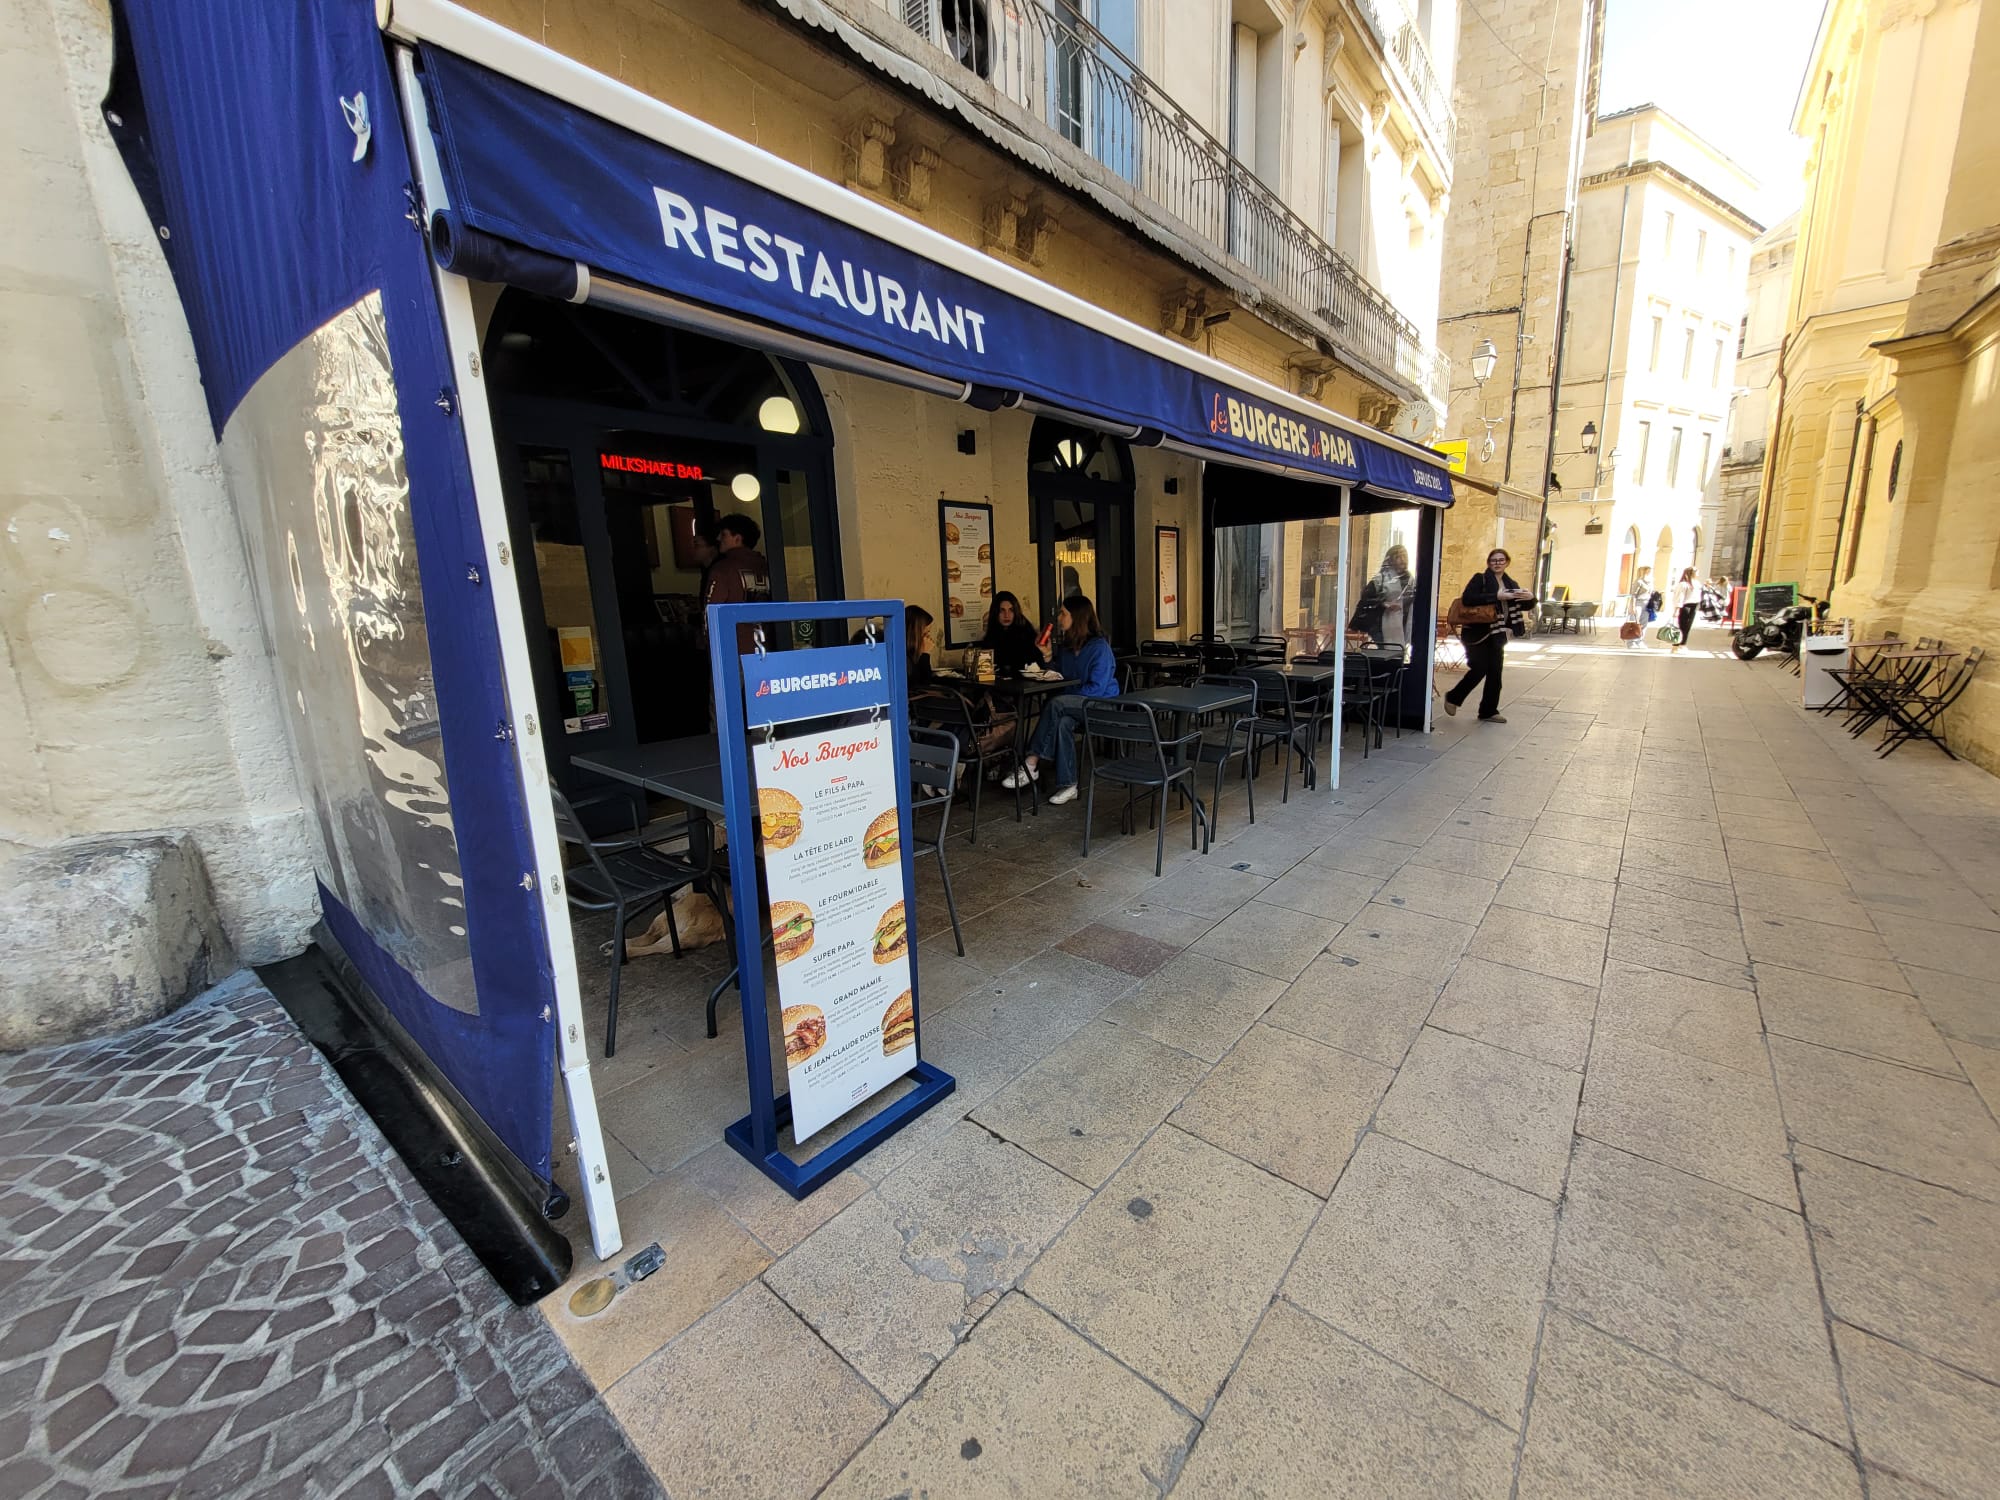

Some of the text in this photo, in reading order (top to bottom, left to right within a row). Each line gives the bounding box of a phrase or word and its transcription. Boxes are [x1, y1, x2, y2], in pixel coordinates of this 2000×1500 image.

[653, 186, 985, 354] RESTAURANT
[1210, 392, 1356, 468] Les BURGERS de PAPA
[601, 454, 703, 480] MILKSHAKE BAR
[1412, 468, 1432, 488] DEPUIS
[756, 667, 882, 697] Les BURGERS de PAPA
[773, 737, 881, 771] Nos Burgers
[814, 780, 865, 798] LE FILS À PAPA
[793, 852, 804, 861] LA
[805, 845, 822, 857] TÊTE
[823, 841, 834, 851] DE
[835, 835, 854, 847] LARD
[818, 899, 827, 907] LE
[812, 947, 836, 964] SUPER
[837, 939, 855, 952] PAPA
[833, 988, 859, 1005] GRAND
[860, 975, 883, 992] MAMIE
[804, 1064, 813, 1075] LE
[813, 1037, 859, 1070] JEAN-CLAUDE
[859, 1025, 881, 1042] DUSSE
